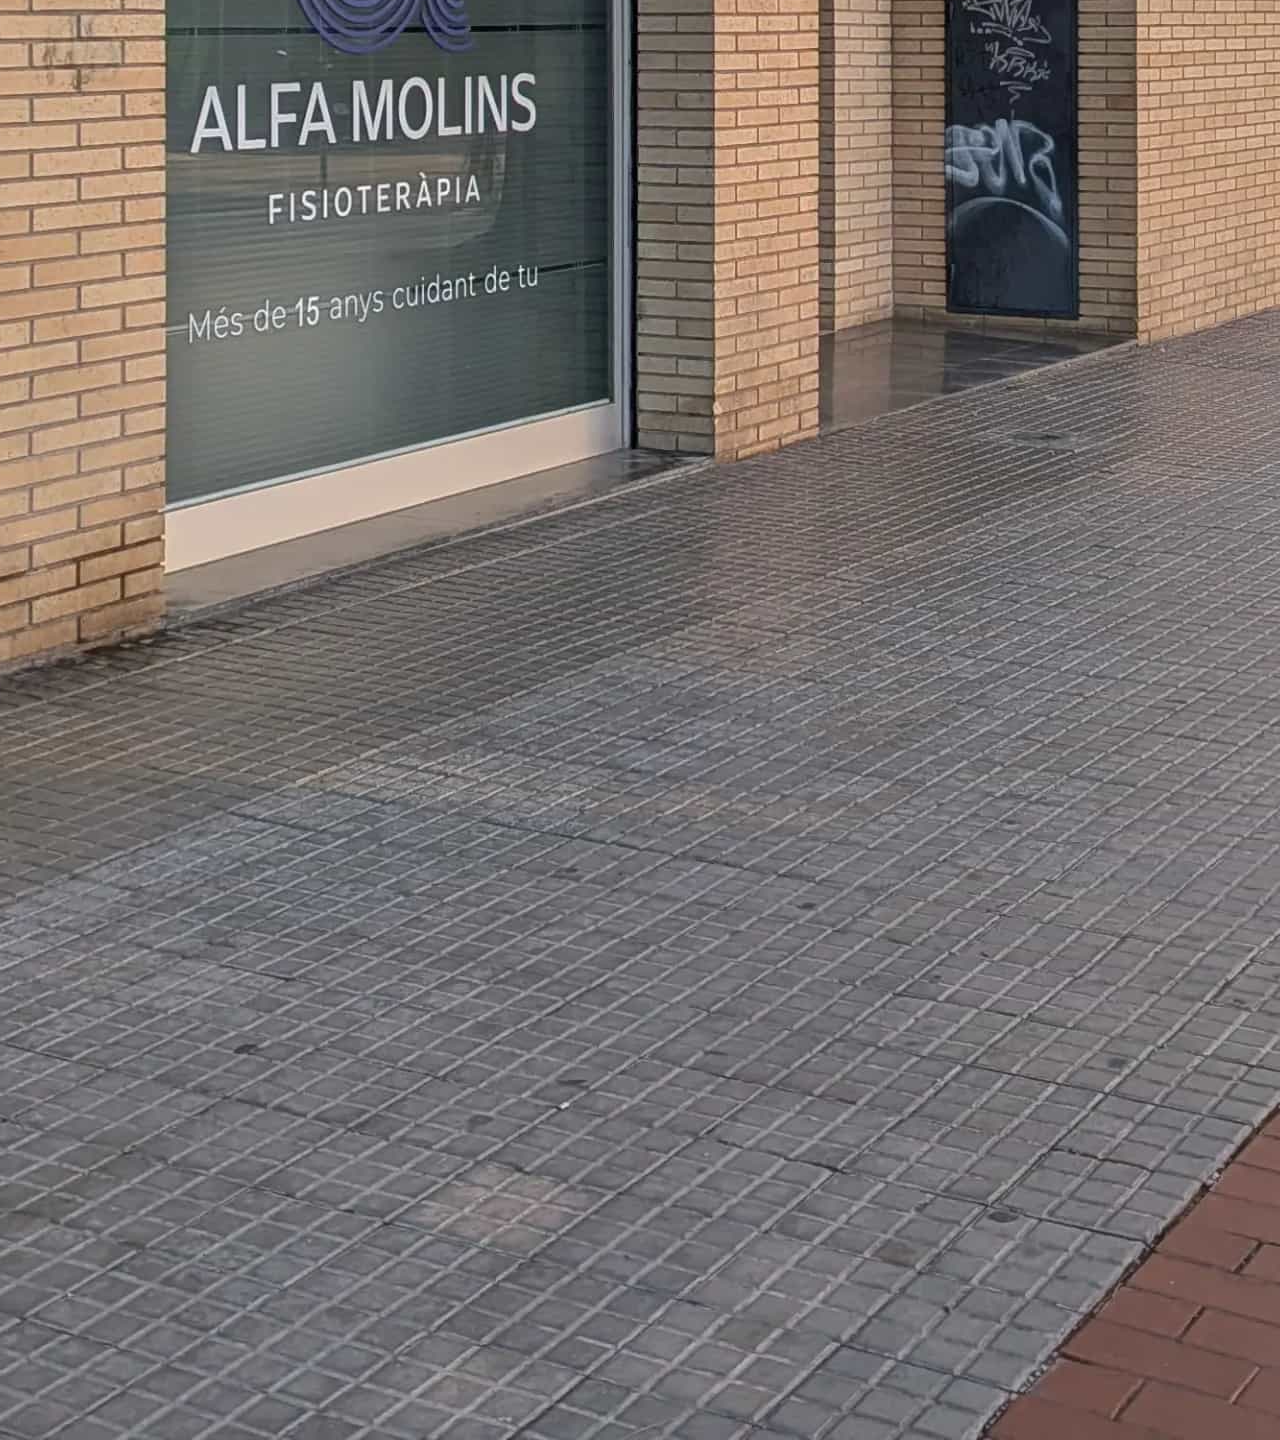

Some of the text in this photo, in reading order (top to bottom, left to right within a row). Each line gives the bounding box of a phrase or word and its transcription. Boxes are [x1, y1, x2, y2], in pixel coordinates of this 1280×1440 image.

[190, 73, 537, 153] ALFA MOLINS
[268, 172, 481, 224] FISIOTERÀPIA
[188, 264, 539, 344] Més de 15 anys cuidant de tu
